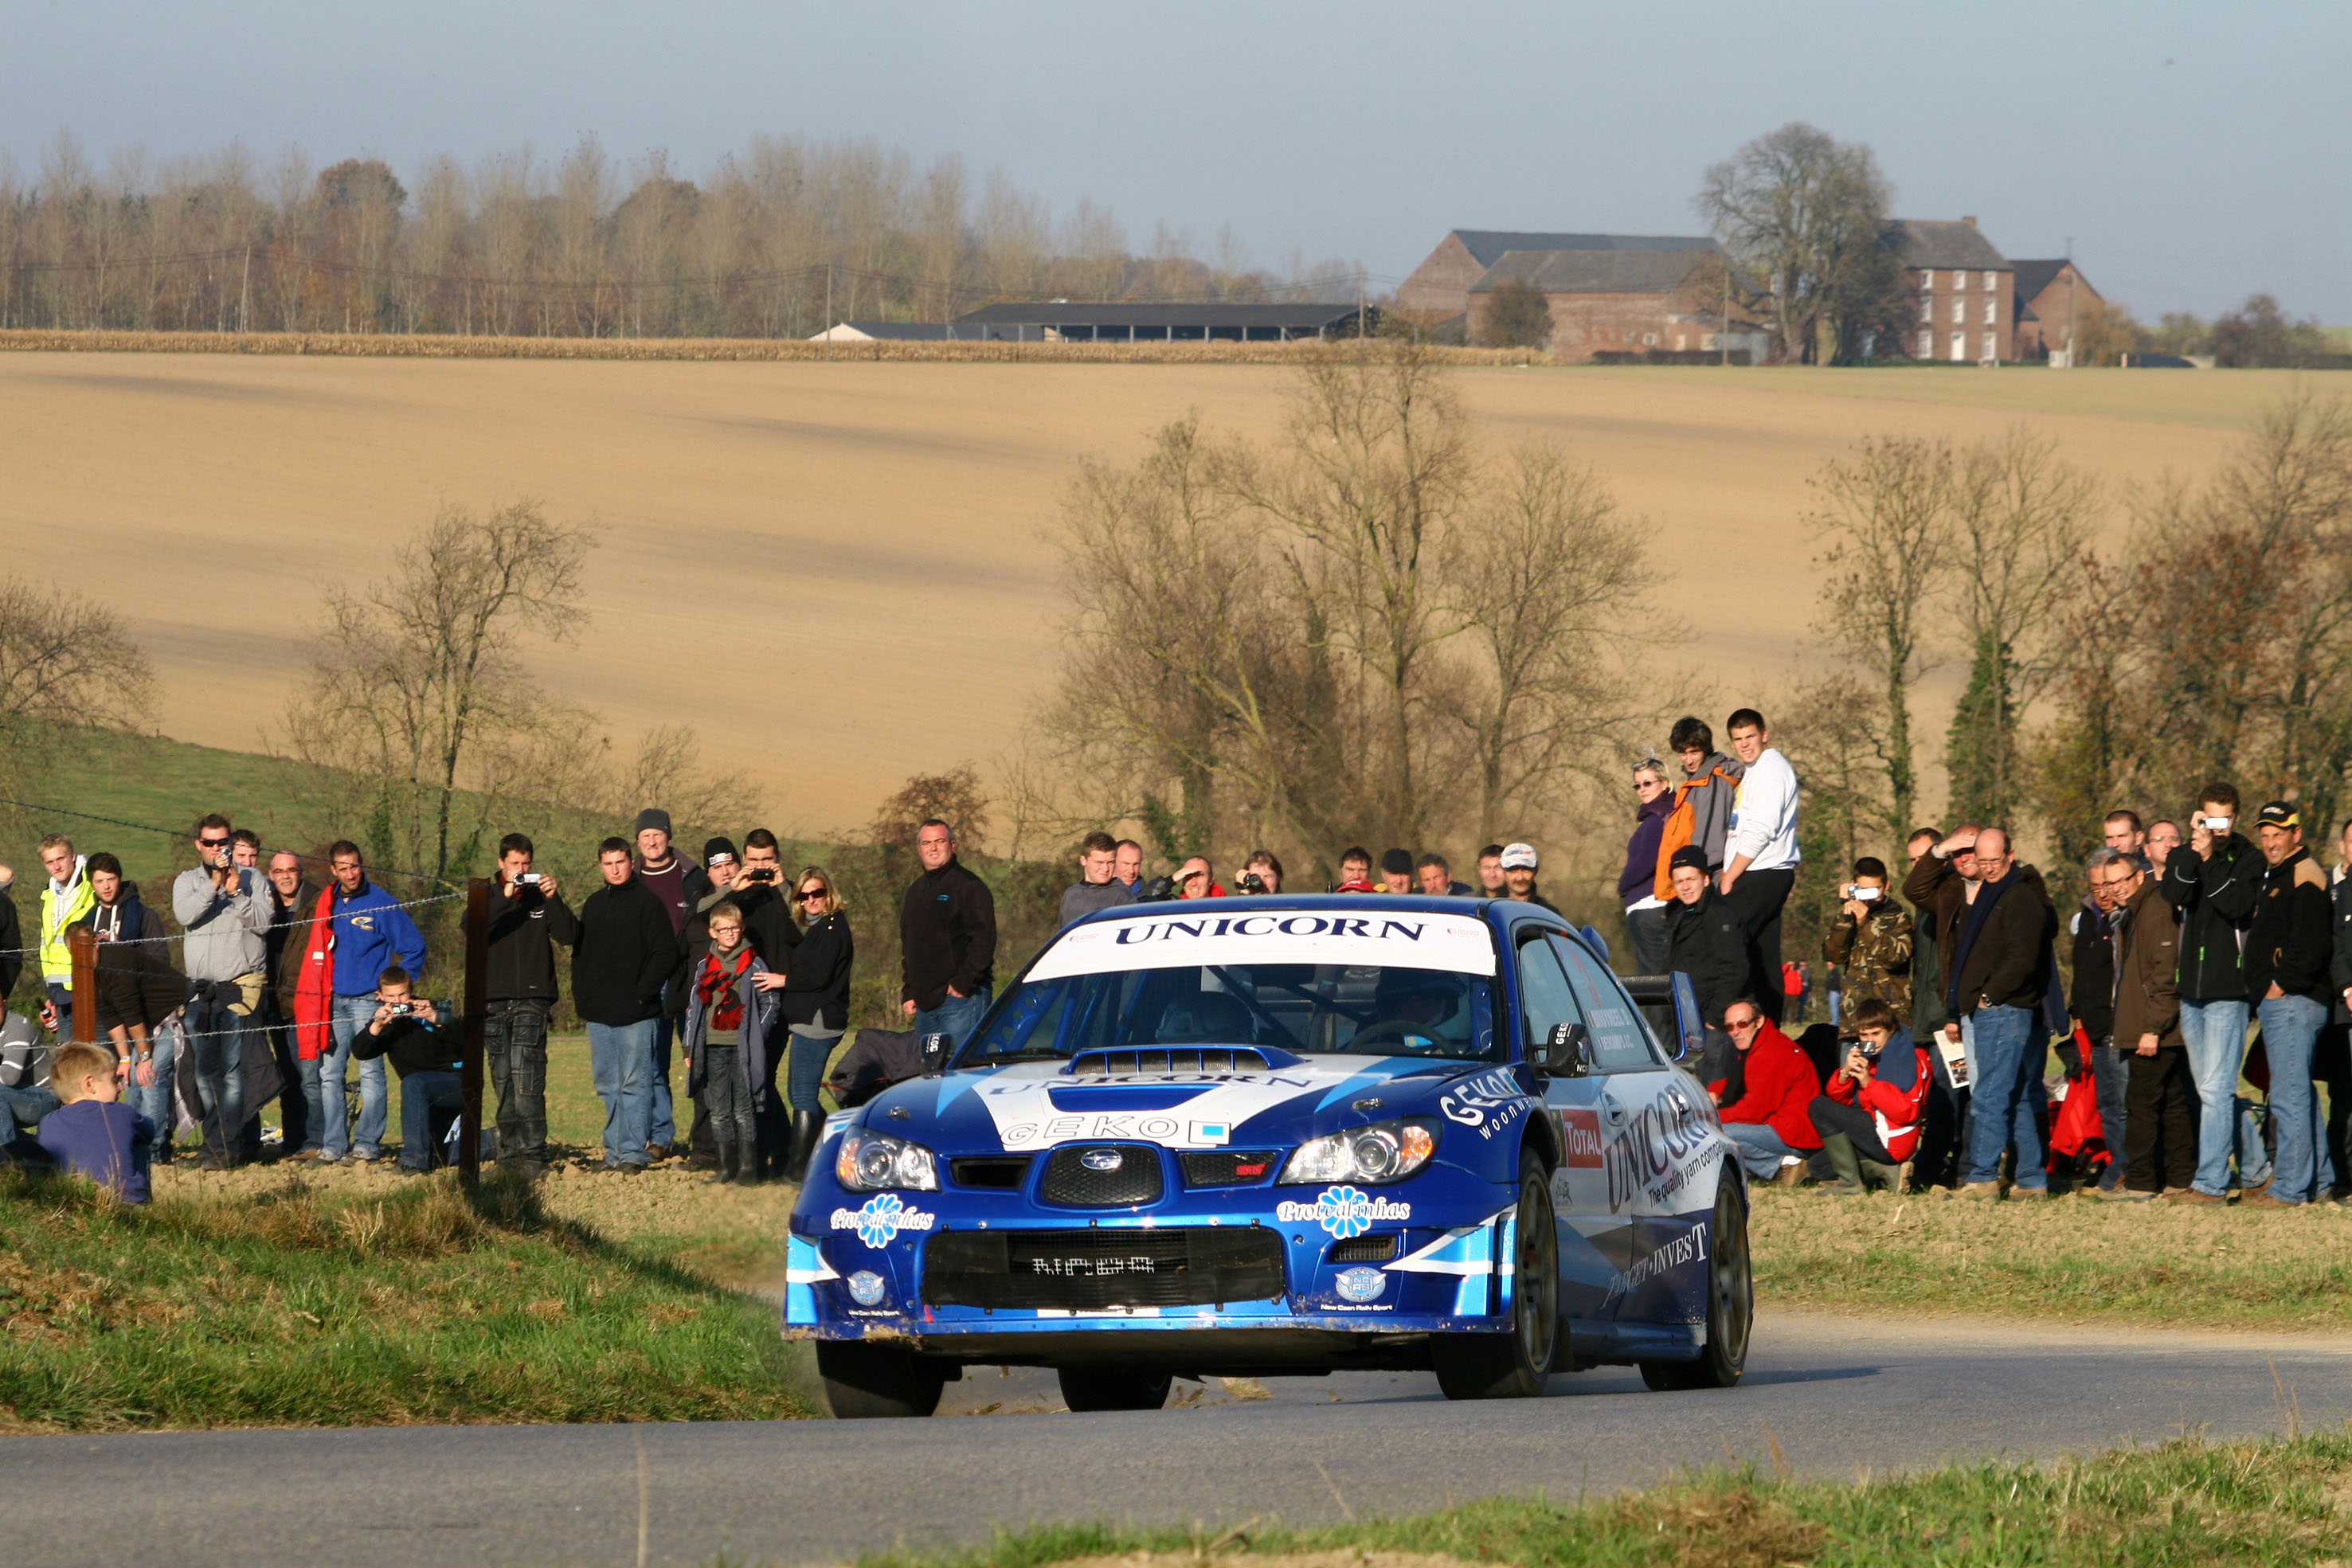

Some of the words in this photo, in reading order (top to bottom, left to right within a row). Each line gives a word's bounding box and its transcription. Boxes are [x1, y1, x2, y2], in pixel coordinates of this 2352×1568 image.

[1115, 917, 1430, 945] UNICORN
[988, 1073, 1318, 1095] UNICORN
[1000, 1115, 1179, 1146] GEKO
[1564, 1121, 1603, 1156] TOTAL
[1648, 1188, 1661, 1208] The
[1661, 1167, 1685, 1202] quality
[1683, 1158, 1702, 1185] yarn
